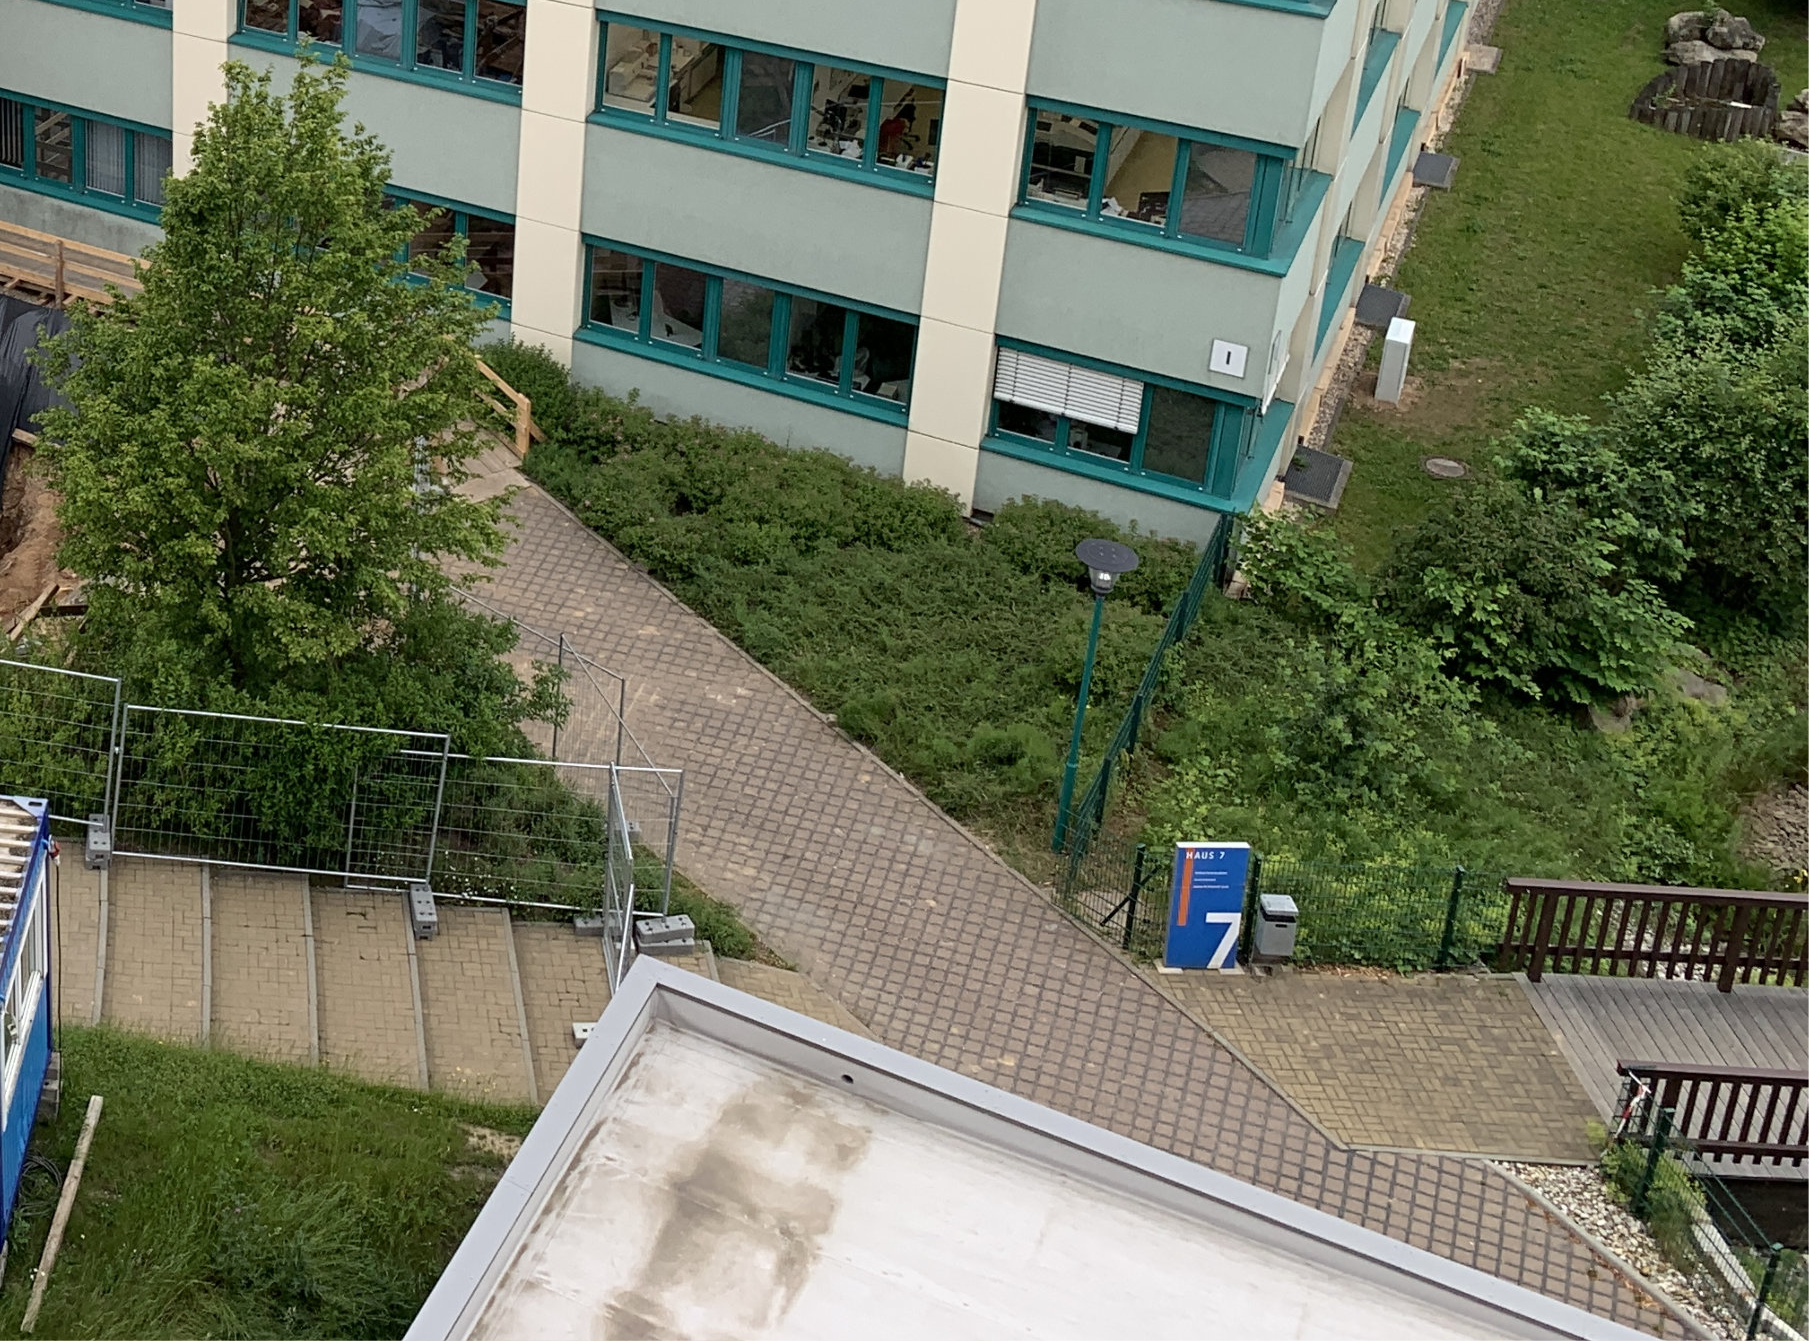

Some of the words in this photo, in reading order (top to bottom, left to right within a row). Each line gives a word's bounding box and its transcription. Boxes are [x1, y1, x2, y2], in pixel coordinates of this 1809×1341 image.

[1186, 851, 1214, 859] HAUS
[1219, 851, 1225, 859] 7
[1205, 912, 1242, 969] 7
